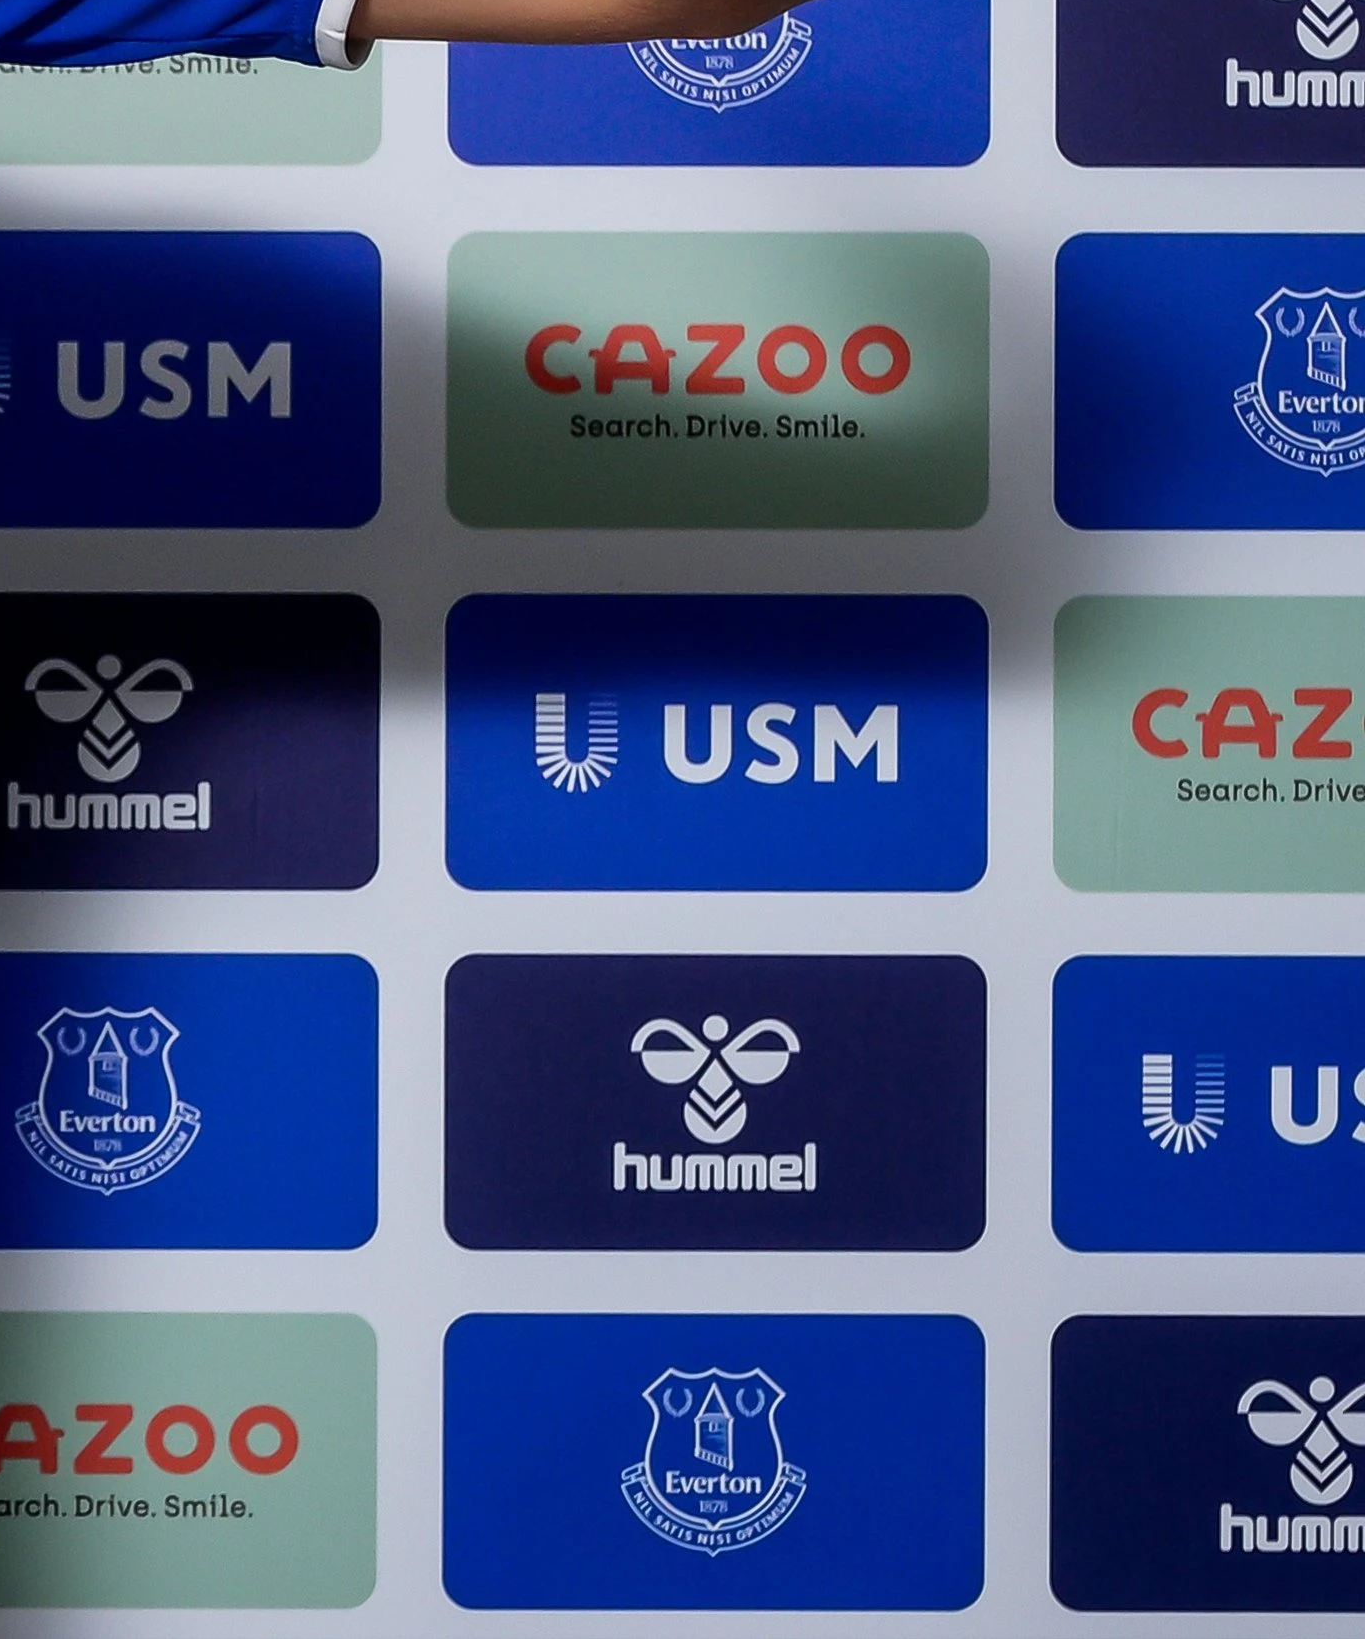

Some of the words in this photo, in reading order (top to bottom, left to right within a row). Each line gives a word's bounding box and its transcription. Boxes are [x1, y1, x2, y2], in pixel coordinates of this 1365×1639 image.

[638, 47, 657, 74] NIL
[659, 71, 698, 98] SATIS
[703, 89, 736, 102] NISI
[741, 47, 800, 97] OPTIMUM
[1226, 58, 1365, 107] humm
[57, 339, 291, 419] USM
[525, 324, 911, 395] CAZOO
[570, 414, 678, 438] Search.
[686, 414, 768, 438] Drive.
[775, 414, 865, 438] Smile.
[1278, 391, 1365, 414] Everto
[1245, 411, 1264, 438] NIL
[1266, 435, 1305, 462] SATIS
[1310, 453, 1343, 466] NISI
[664, 703, 898, 783] USM
[1131, 687, 1365, 758] CAZ
[7, 781, 210, 830] hummel
[1176, 777, 1284, 801] Search.
[1292, 777, 1365, 801] Drive
[60, 1110, 156, 1133] Everton
[614, 1142, 817, 1191] hummel
[74, 1494, 156, 1518] Drive.
[163, 1494, 253, 1518] Smile.
[666, 1471, 762, 1494] Everton
[633, 1491, 652, 1518] NIL
[654, 1515, 693, 1542] SATIS
[698, 1533, 731, 1546] NISI
[1220, 1503, 1365, 1552] humm
